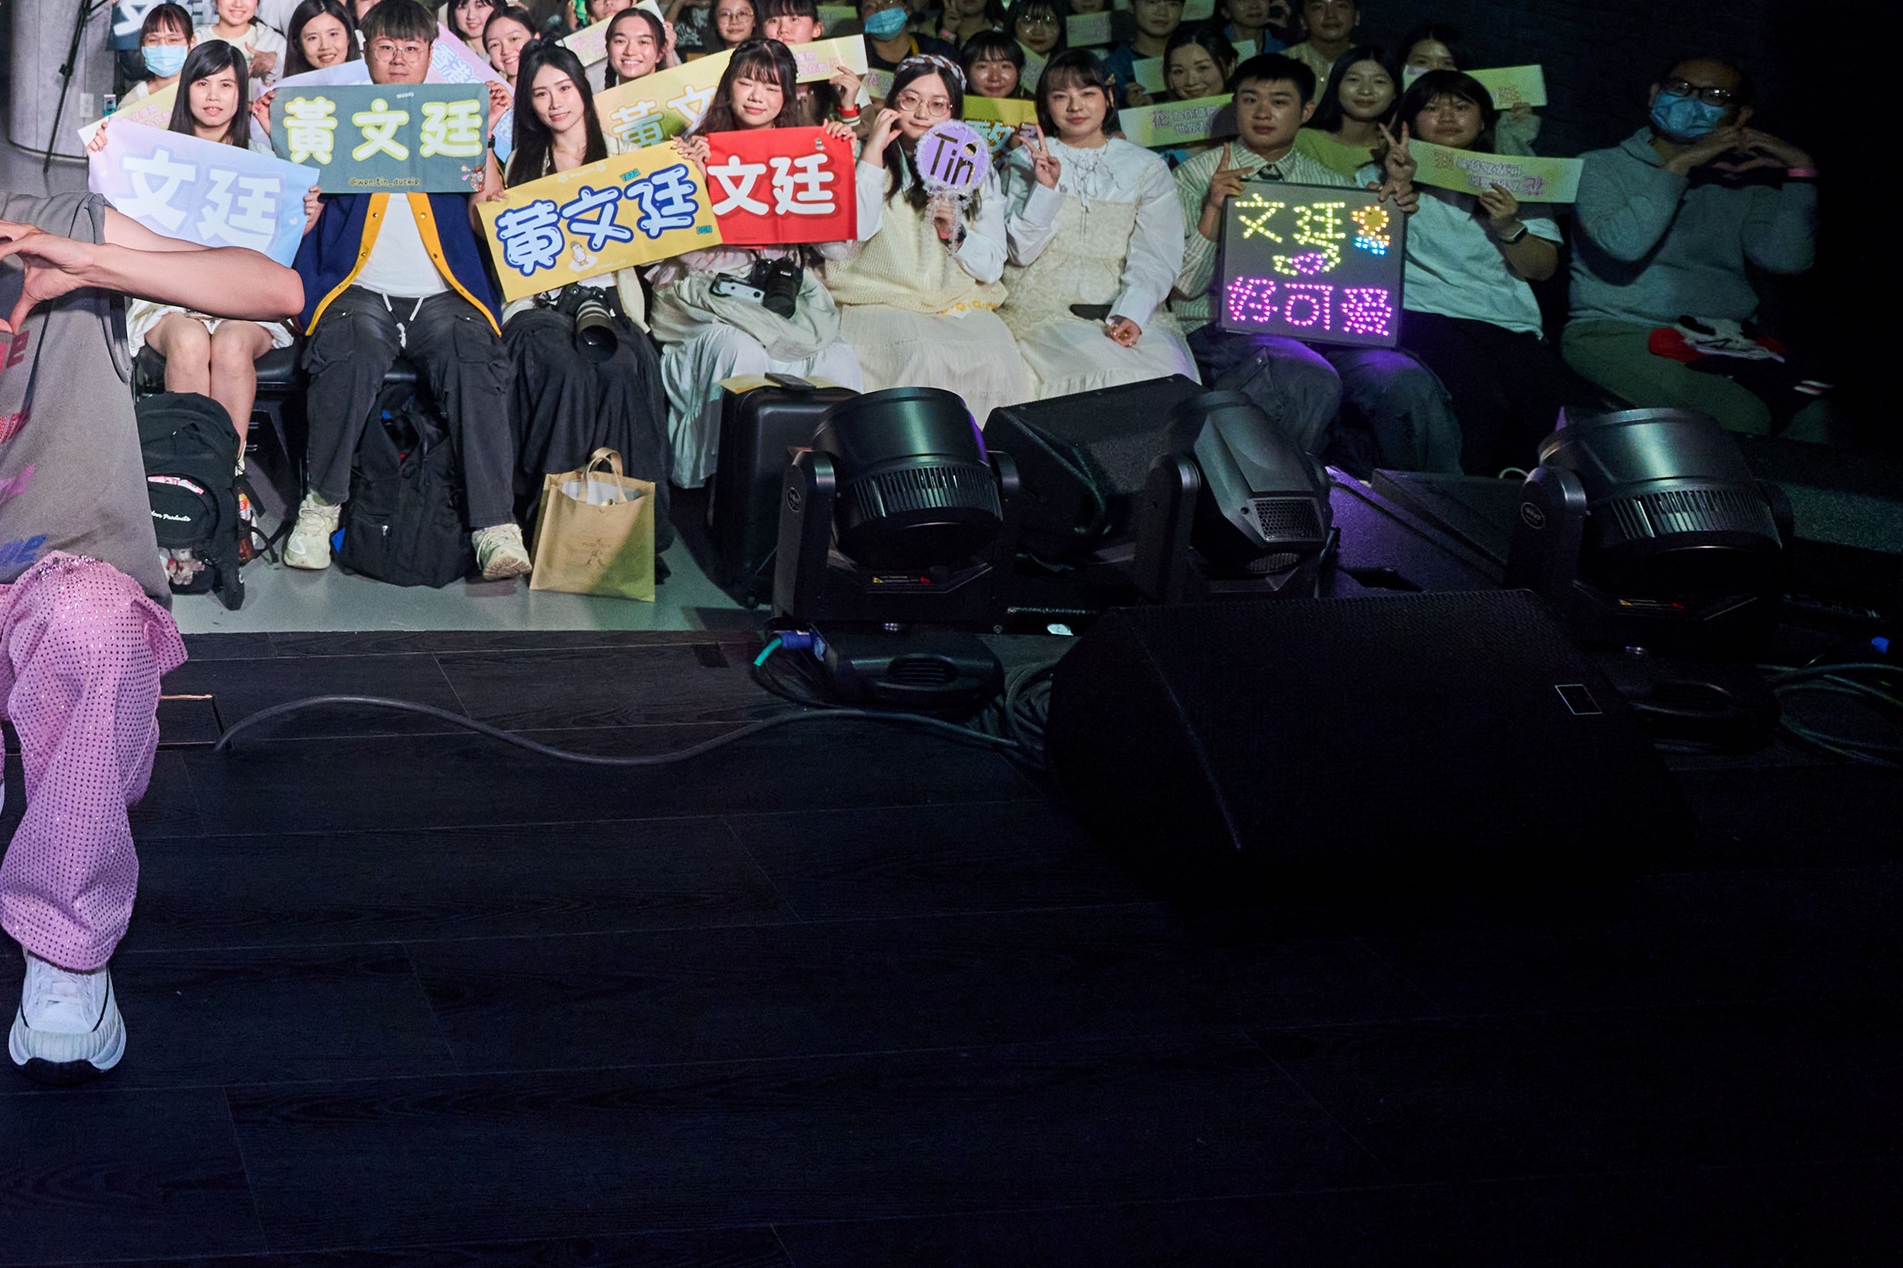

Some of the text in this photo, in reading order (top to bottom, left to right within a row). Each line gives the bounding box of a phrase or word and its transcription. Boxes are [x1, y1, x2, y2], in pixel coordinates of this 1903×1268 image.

[283, 96, 483, 165] 黃文廷
[929, 131, 975, 185] Tin
[94, 148, 282, 251] 文廷
[706, 153, 836, 216] 文廷
[495, 163, 699, 277] 黃文廷
[1234, 192, 1347, 248] 文廷
[1226, 276, 1393, 338] 好可愛
